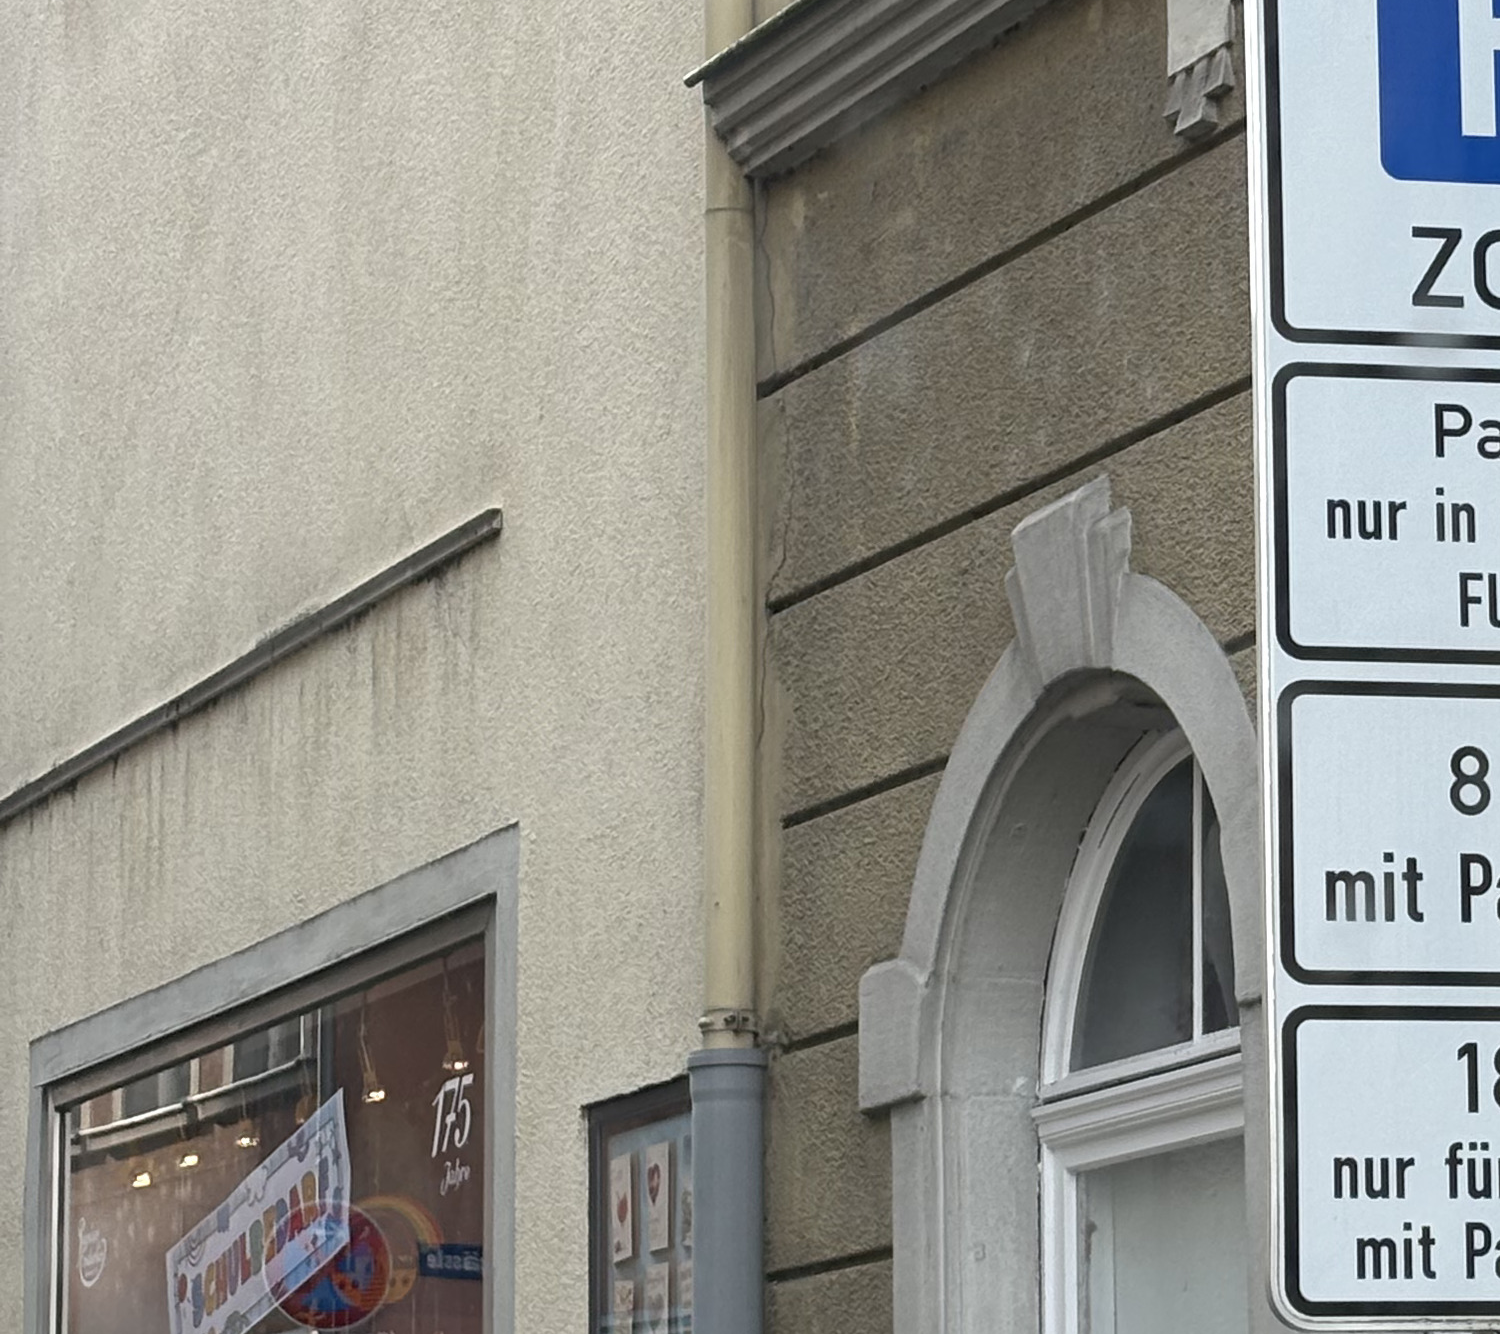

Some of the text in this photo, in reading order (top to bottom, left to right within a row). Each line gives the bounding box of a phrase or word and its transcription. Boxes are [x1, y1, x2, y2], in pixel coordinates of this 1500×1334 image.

[1326, 499, 1407, 541] nur
[1435, 487, 1476, 543] in
[1325, 852, 1424, 923] mit
[432, 1073, 474, 1158] 175
[1333, 1156, 1416, 1200] nur
[1356, 1221, 1437, 1280] mit
